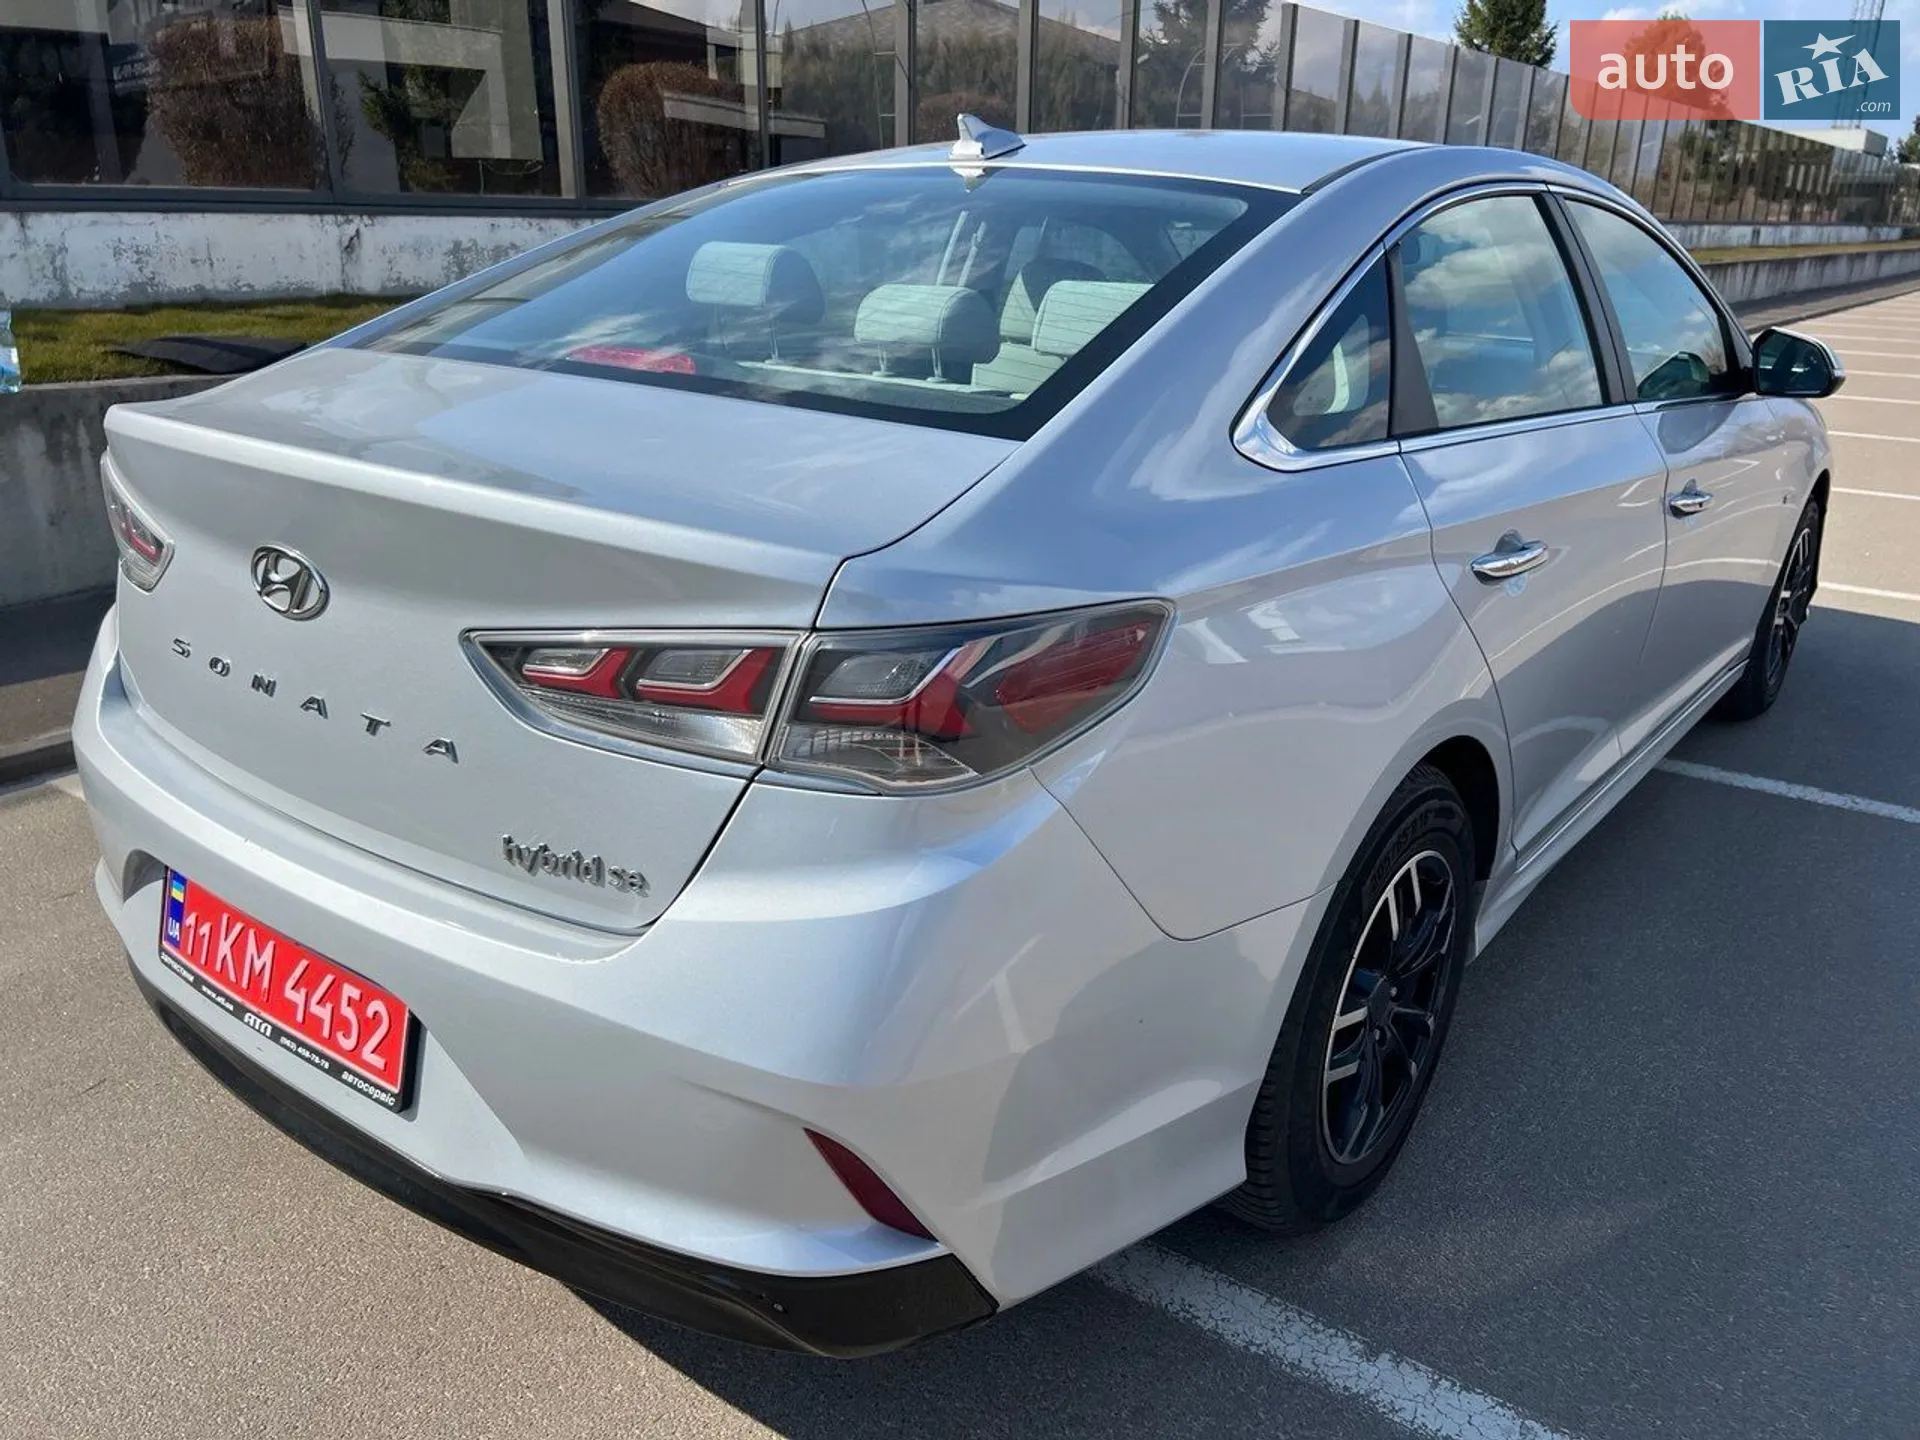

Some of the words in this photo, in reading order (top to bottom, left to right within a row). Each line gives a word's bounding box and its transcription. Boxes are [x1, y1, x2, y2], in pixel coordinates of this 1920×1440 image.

[171, 636, 460, 765] SONATA
[501, 833, 605, 890] hybrid
[167, 916, 181, 942] UA
[283, 958, 394, 1073] 4452
